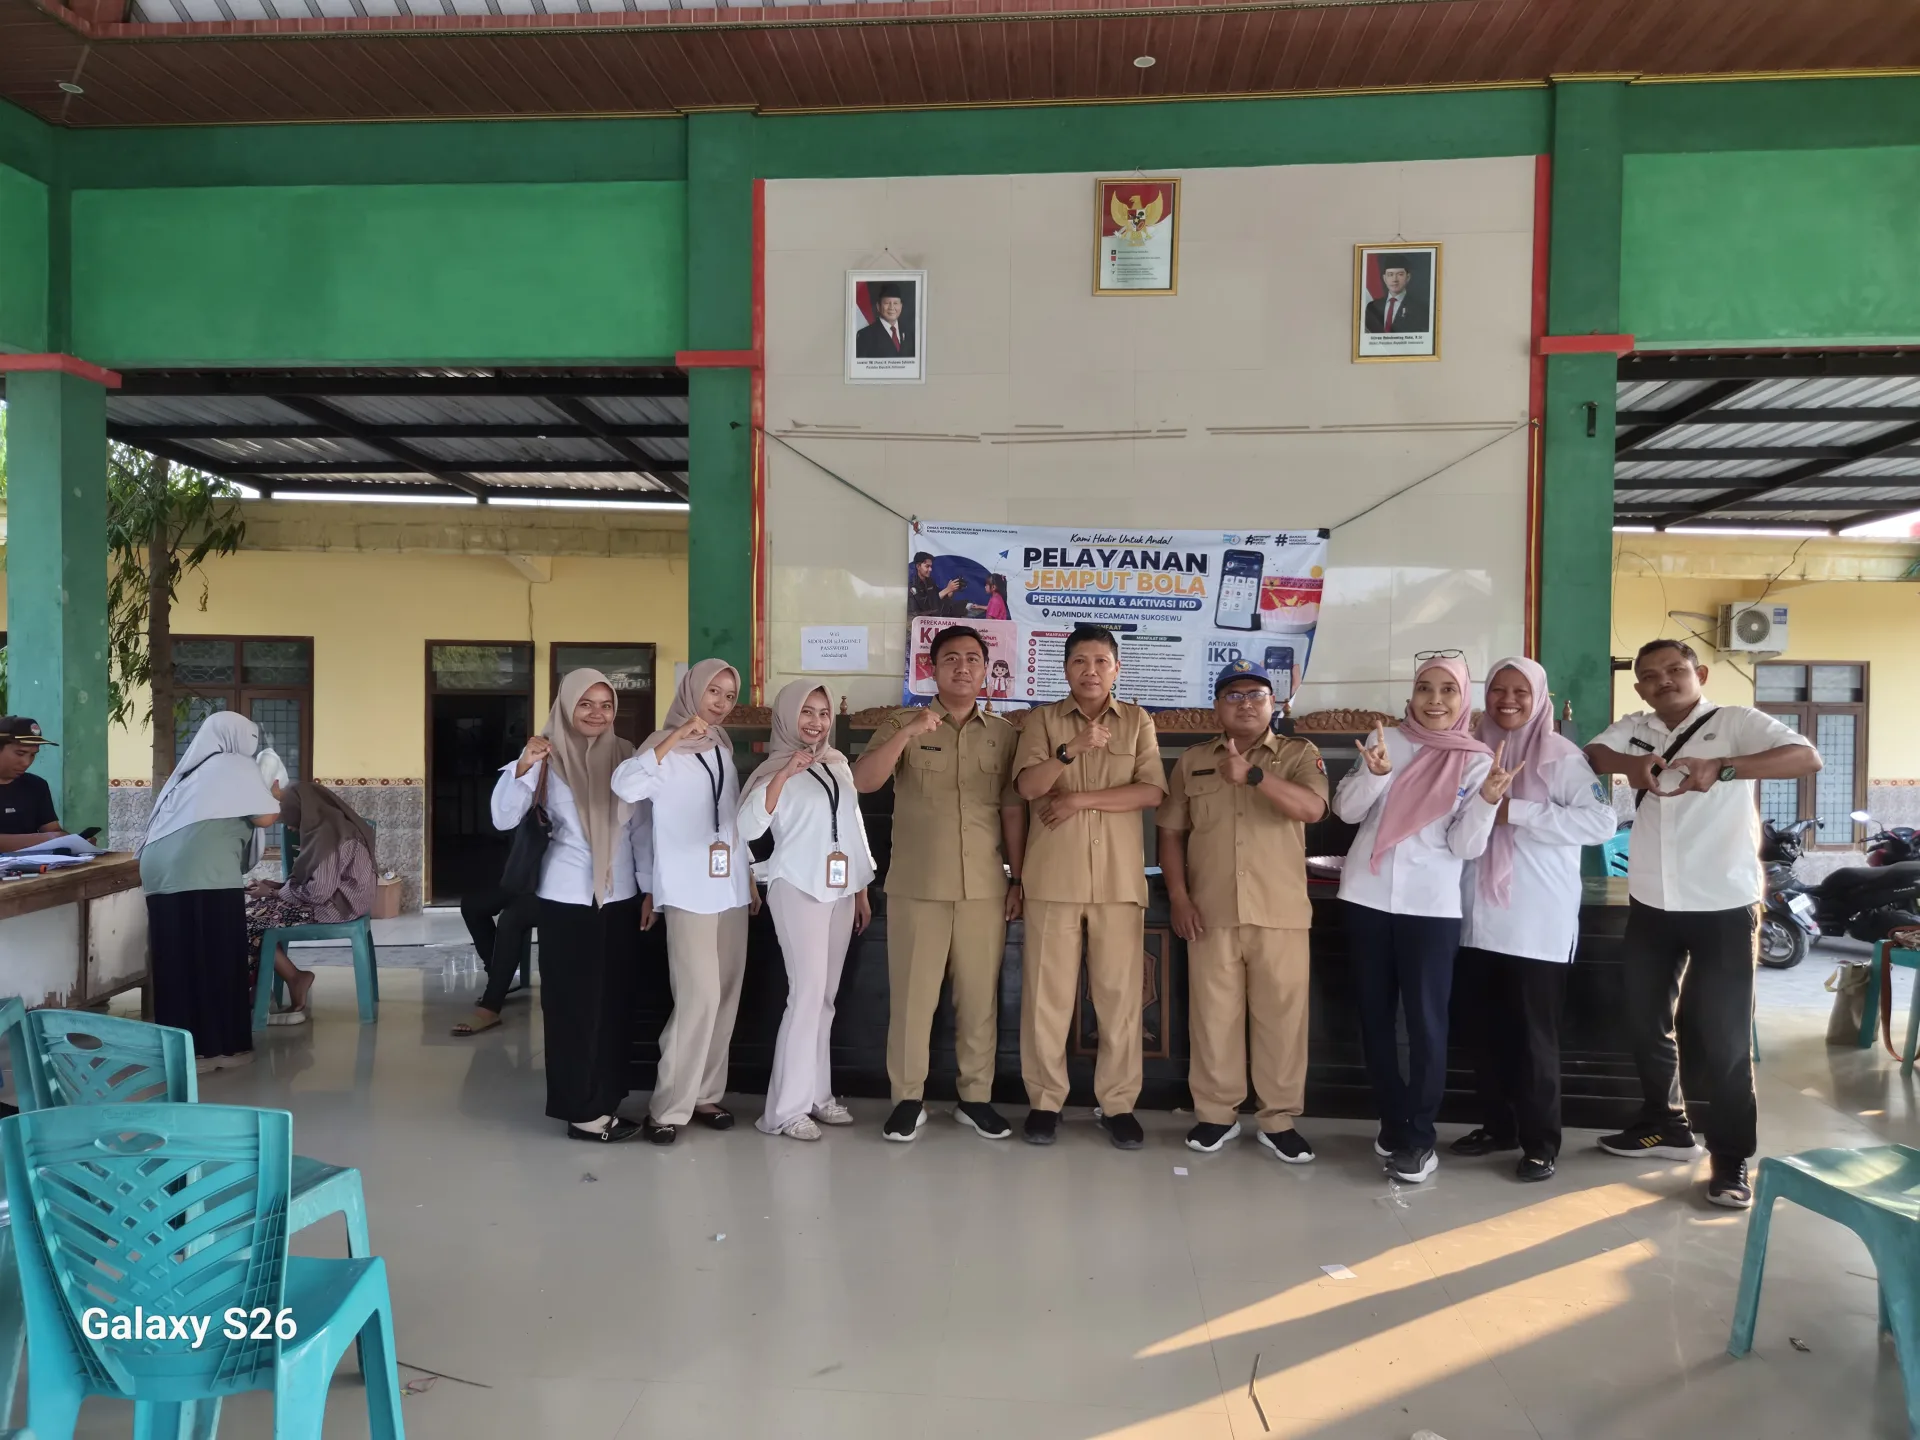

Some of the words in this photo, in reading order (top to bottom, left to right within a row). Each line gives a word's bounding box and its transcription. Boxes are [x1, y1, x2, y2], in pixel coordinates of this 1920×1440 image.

[1070, 534, 1091, 543] Kami
[1092, 534, 1116, 544] Hadir
[1118, 535, 1143, 544] Untuk
[1145, 535, 1172, 545] Anda!
[1024, 548, 1208, 574] PELAYANAN
[1024, 570, 1132, 592] JEMPUT
[1137, 572, 1207, 596] BOLA
[1032, 594, 1096, 605] PEREKAMAN
[1099, 596, 1115, 606] KIA
[1119, 597, 1127, 606] &
[1129, 598, 1176, 608] AKTIVASI
[1179, 599, 1196, 609] IKD
[1051, 610, 1092, 619] ADMINDUK
[1141, 614, 1182, 622] SUKOSEWU
[1208, 648, 1242, 662] IKD
